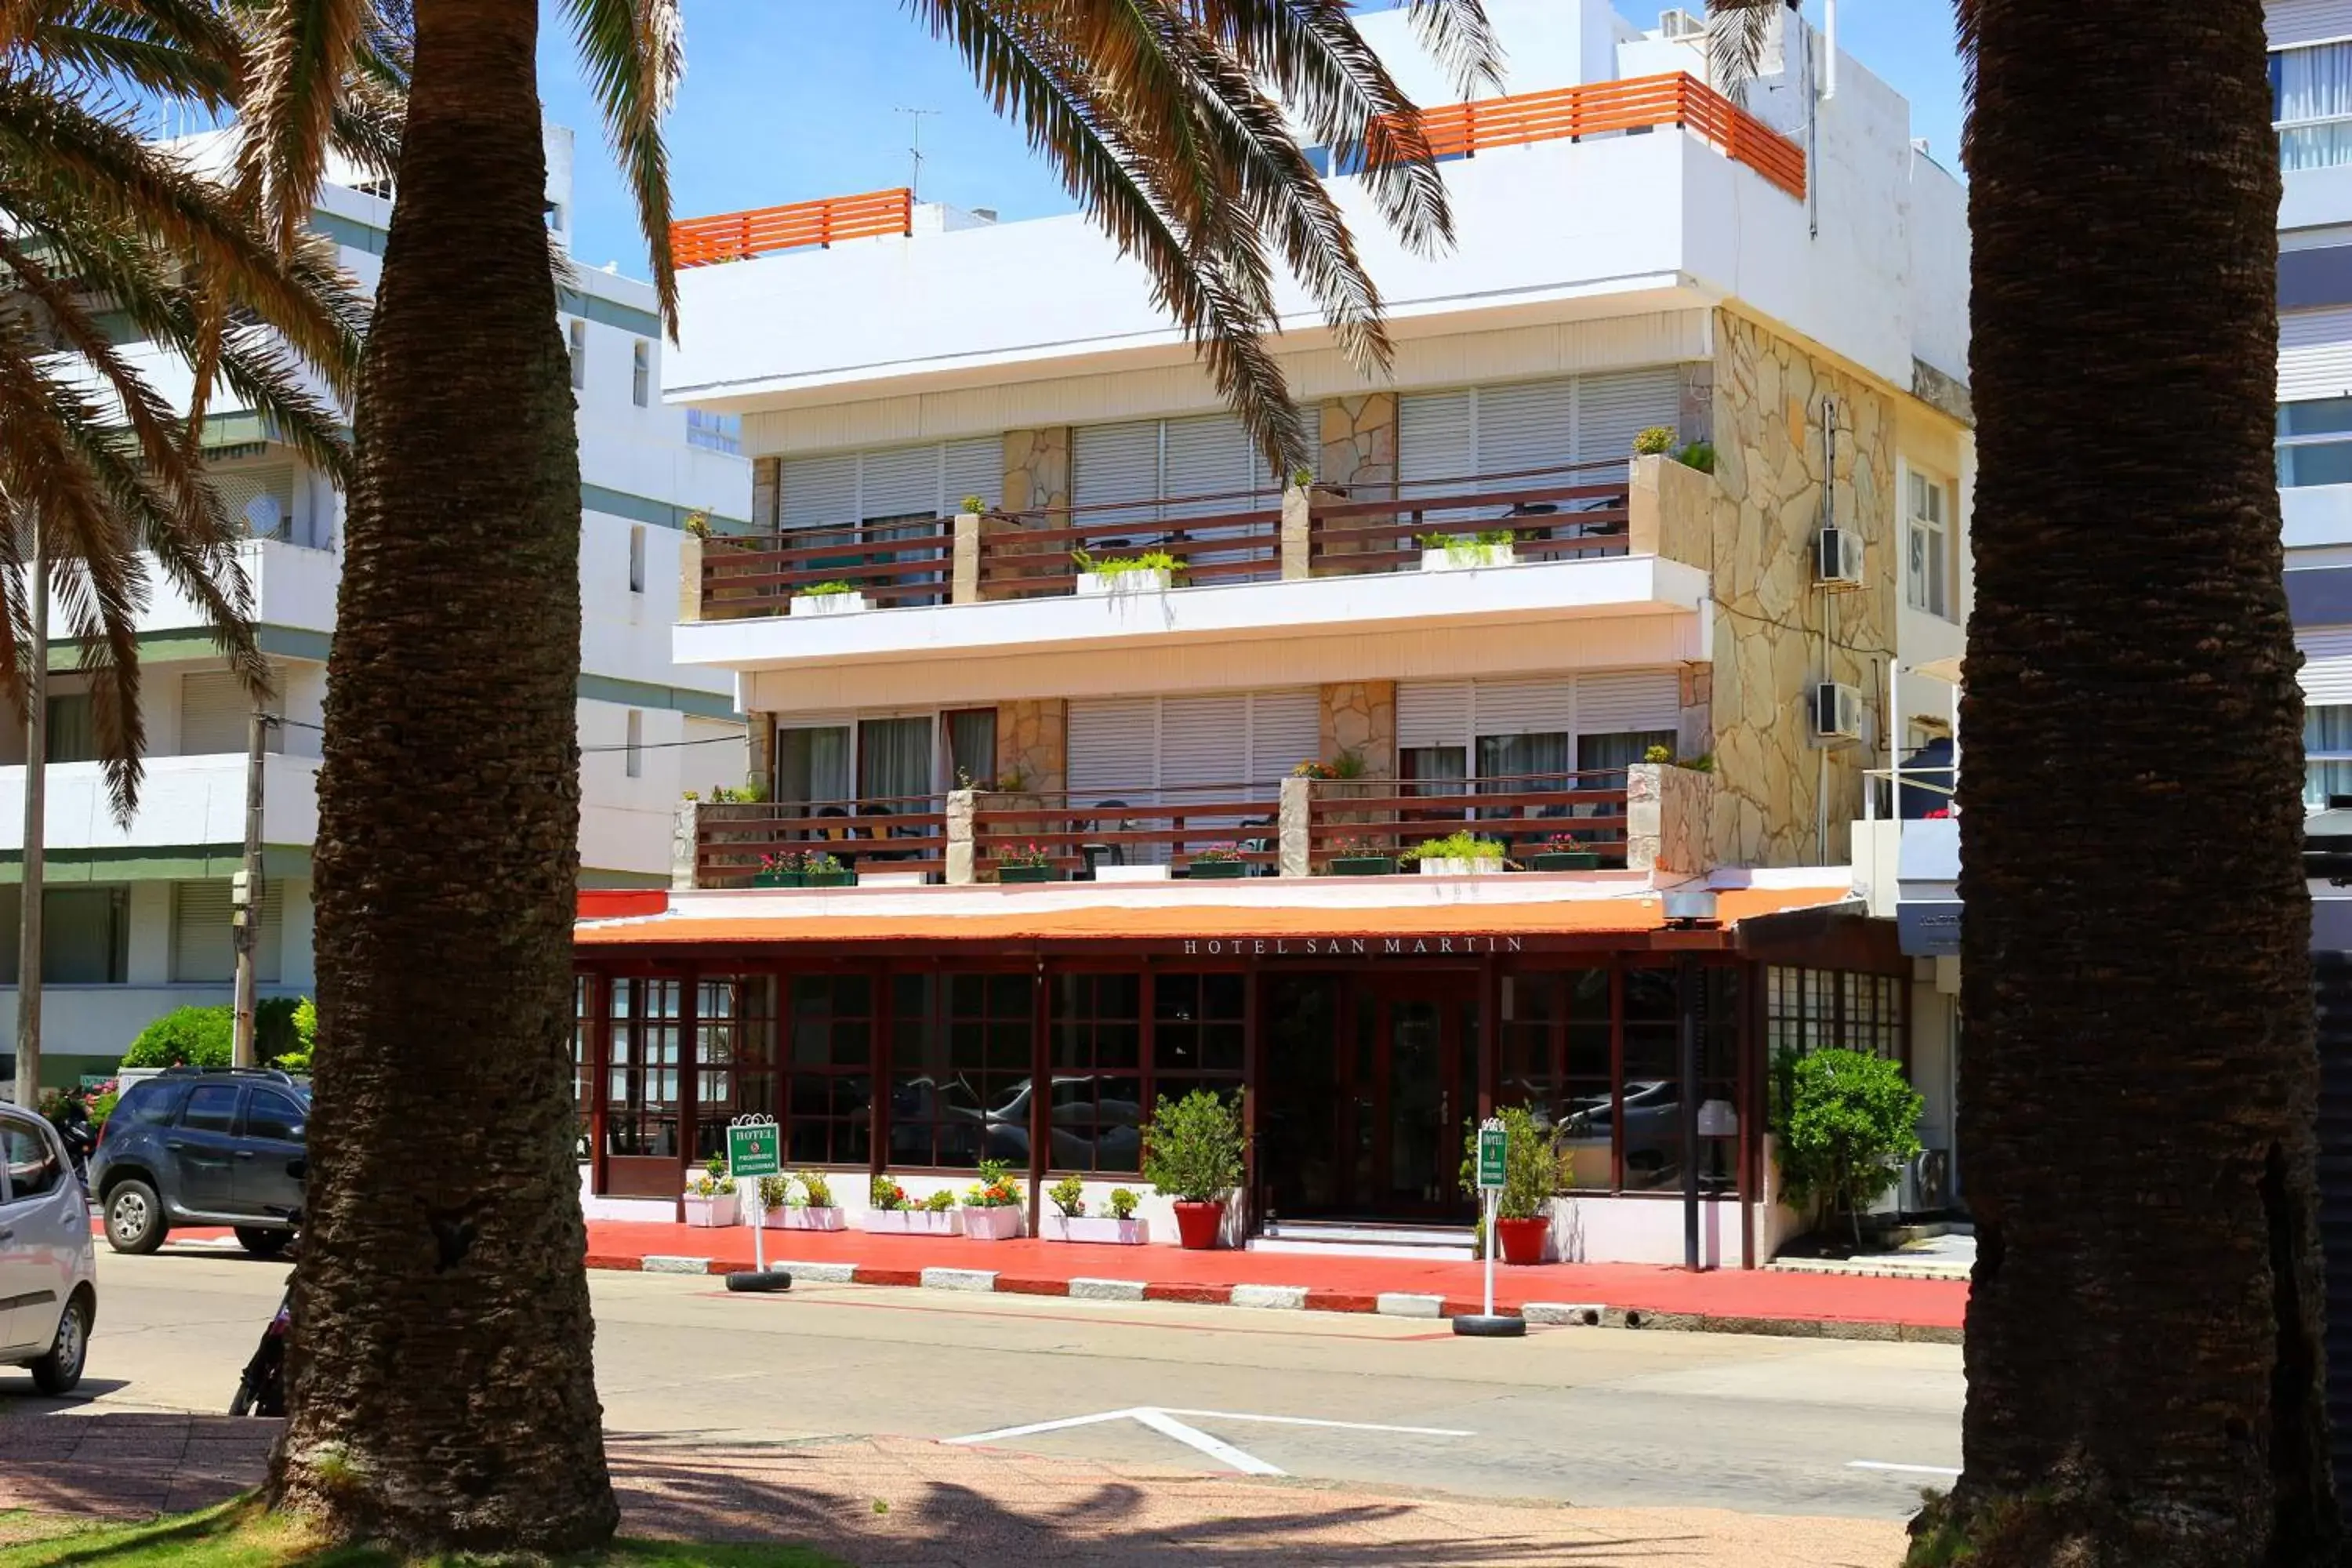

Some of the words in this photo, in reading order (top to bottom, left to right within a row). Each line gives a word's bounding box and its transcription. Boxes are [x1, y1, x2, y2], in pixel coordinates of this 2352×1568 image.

[1185, 940, 1288, 954] HOTEL
[1306, 939, 1365, 954] SAN
[1385, 937, 1521, 954] MARTIN
[736, 1129, 775, 1141] HOTEL
